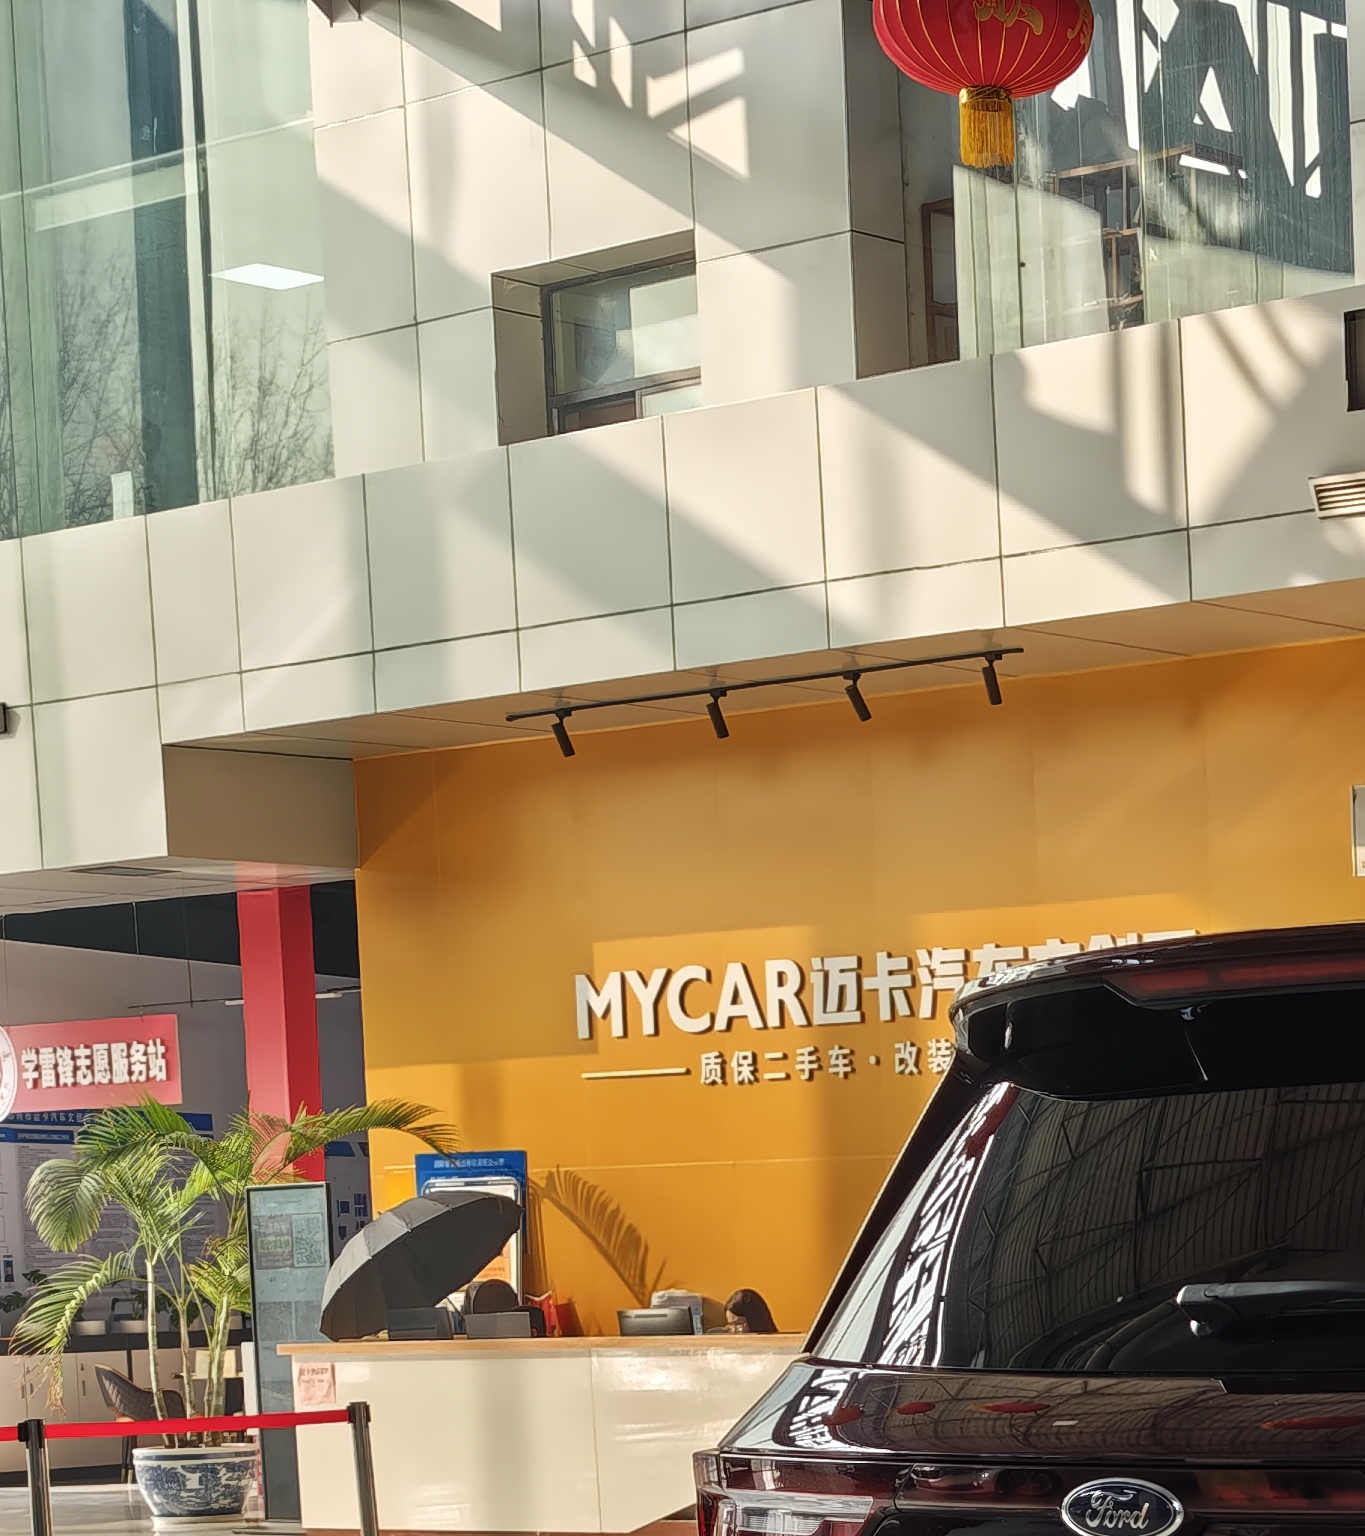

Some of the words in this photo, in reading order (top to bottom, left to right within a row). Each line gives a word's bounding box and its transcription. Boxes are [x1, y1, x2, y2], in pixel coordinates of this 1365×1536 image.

[21, 1037, 168, 1090] 学雷锋志愿服务站
[1080, 1489, 1150, 1530] Ford
